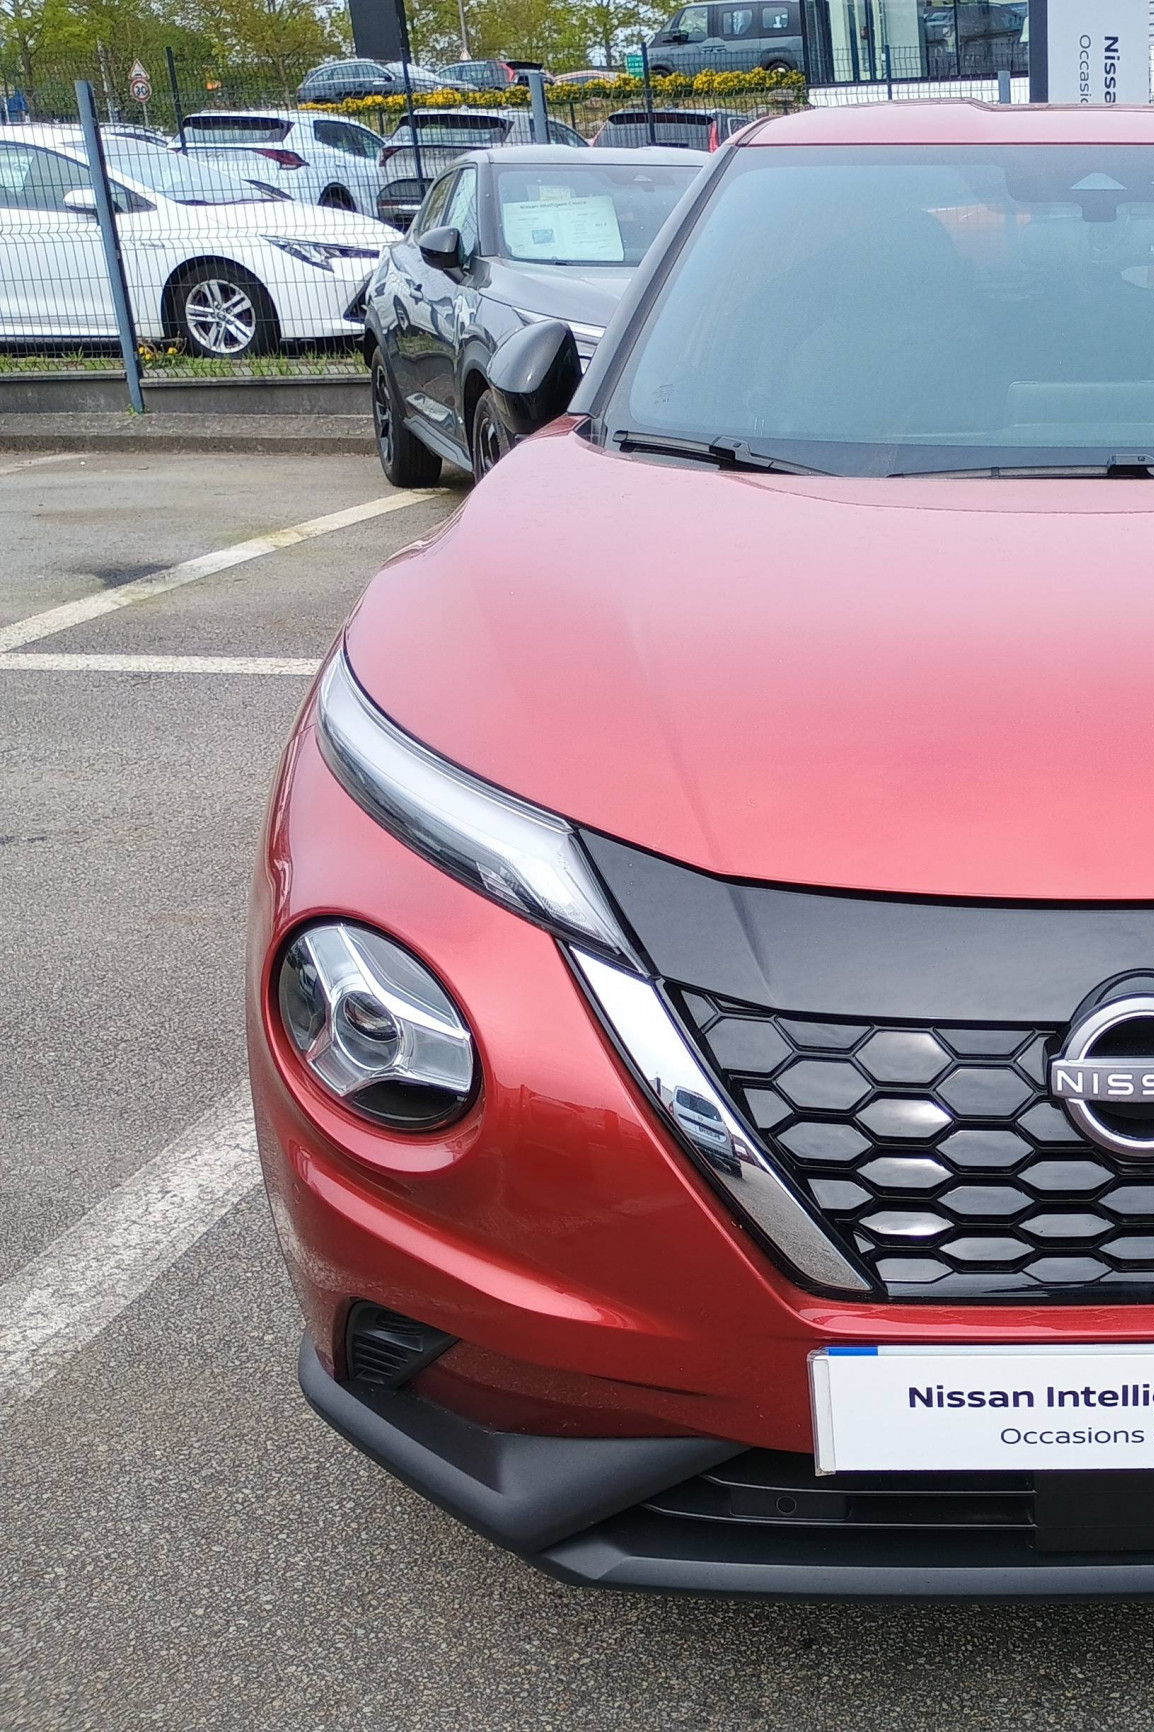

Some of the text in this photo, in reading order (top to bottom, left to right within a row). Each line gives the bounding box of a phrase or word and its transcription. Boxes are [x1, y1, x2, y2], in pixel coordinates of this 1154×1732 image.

[135, 85, 148, 96] 30
[908, 1385, 1035, 1408] Nissan
[1000, 1427, 1145, 1445] Occasions
